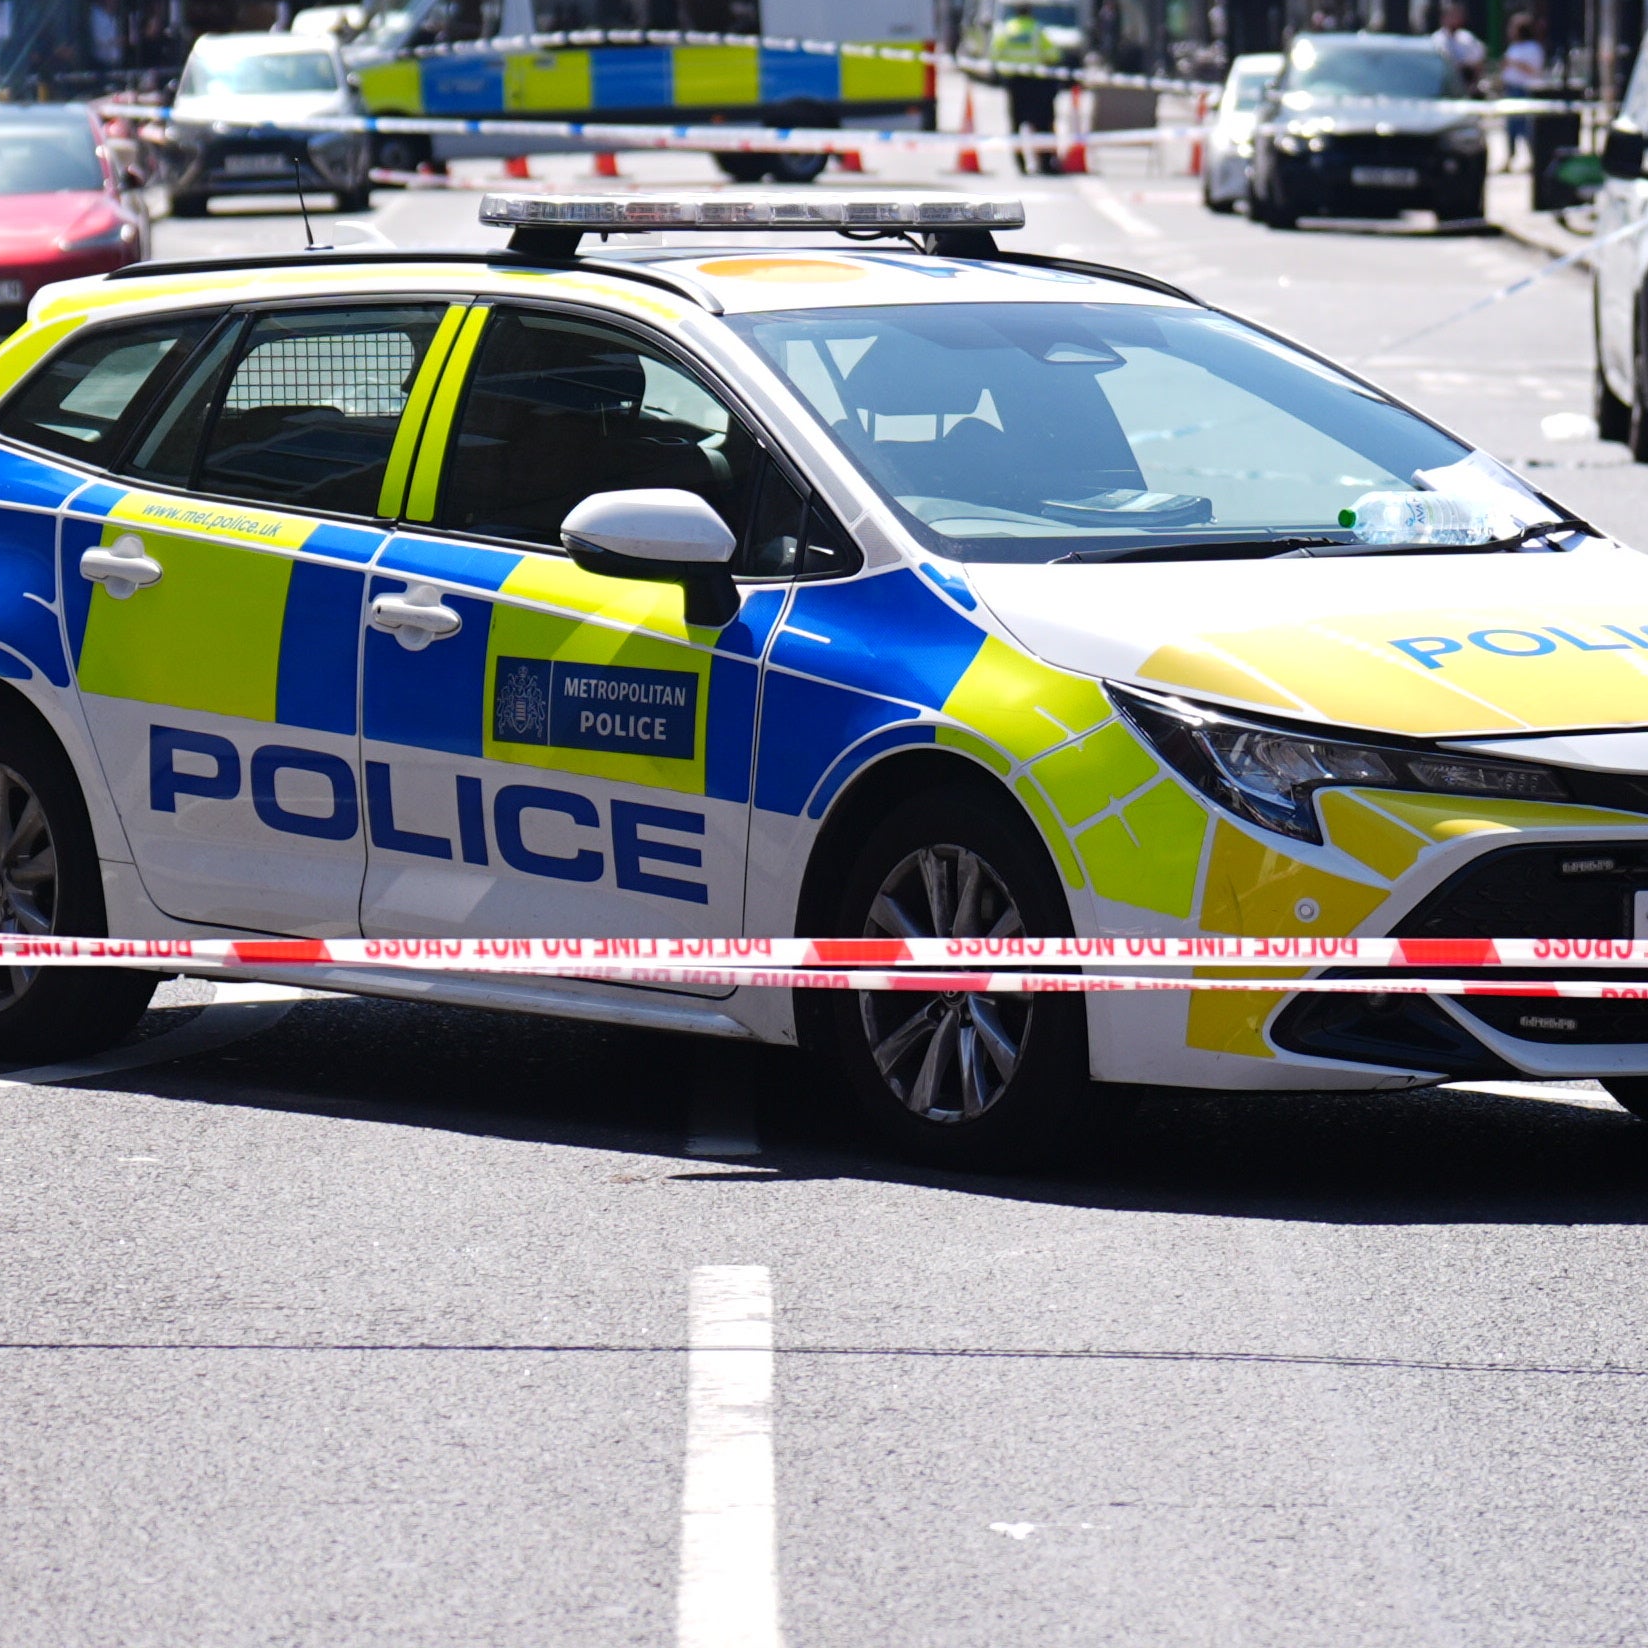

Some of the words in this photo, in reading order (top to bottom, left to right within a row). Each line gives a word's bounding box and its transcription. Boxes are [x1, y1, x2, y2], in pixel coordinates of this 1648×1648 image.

[142, 501, 282, 538] www.met.police.uk
[563, 677, 686, 707] METROPOLITAN
[579, 711, 668, 741] POLICE
[151, 723, 709, 899] POLICE
